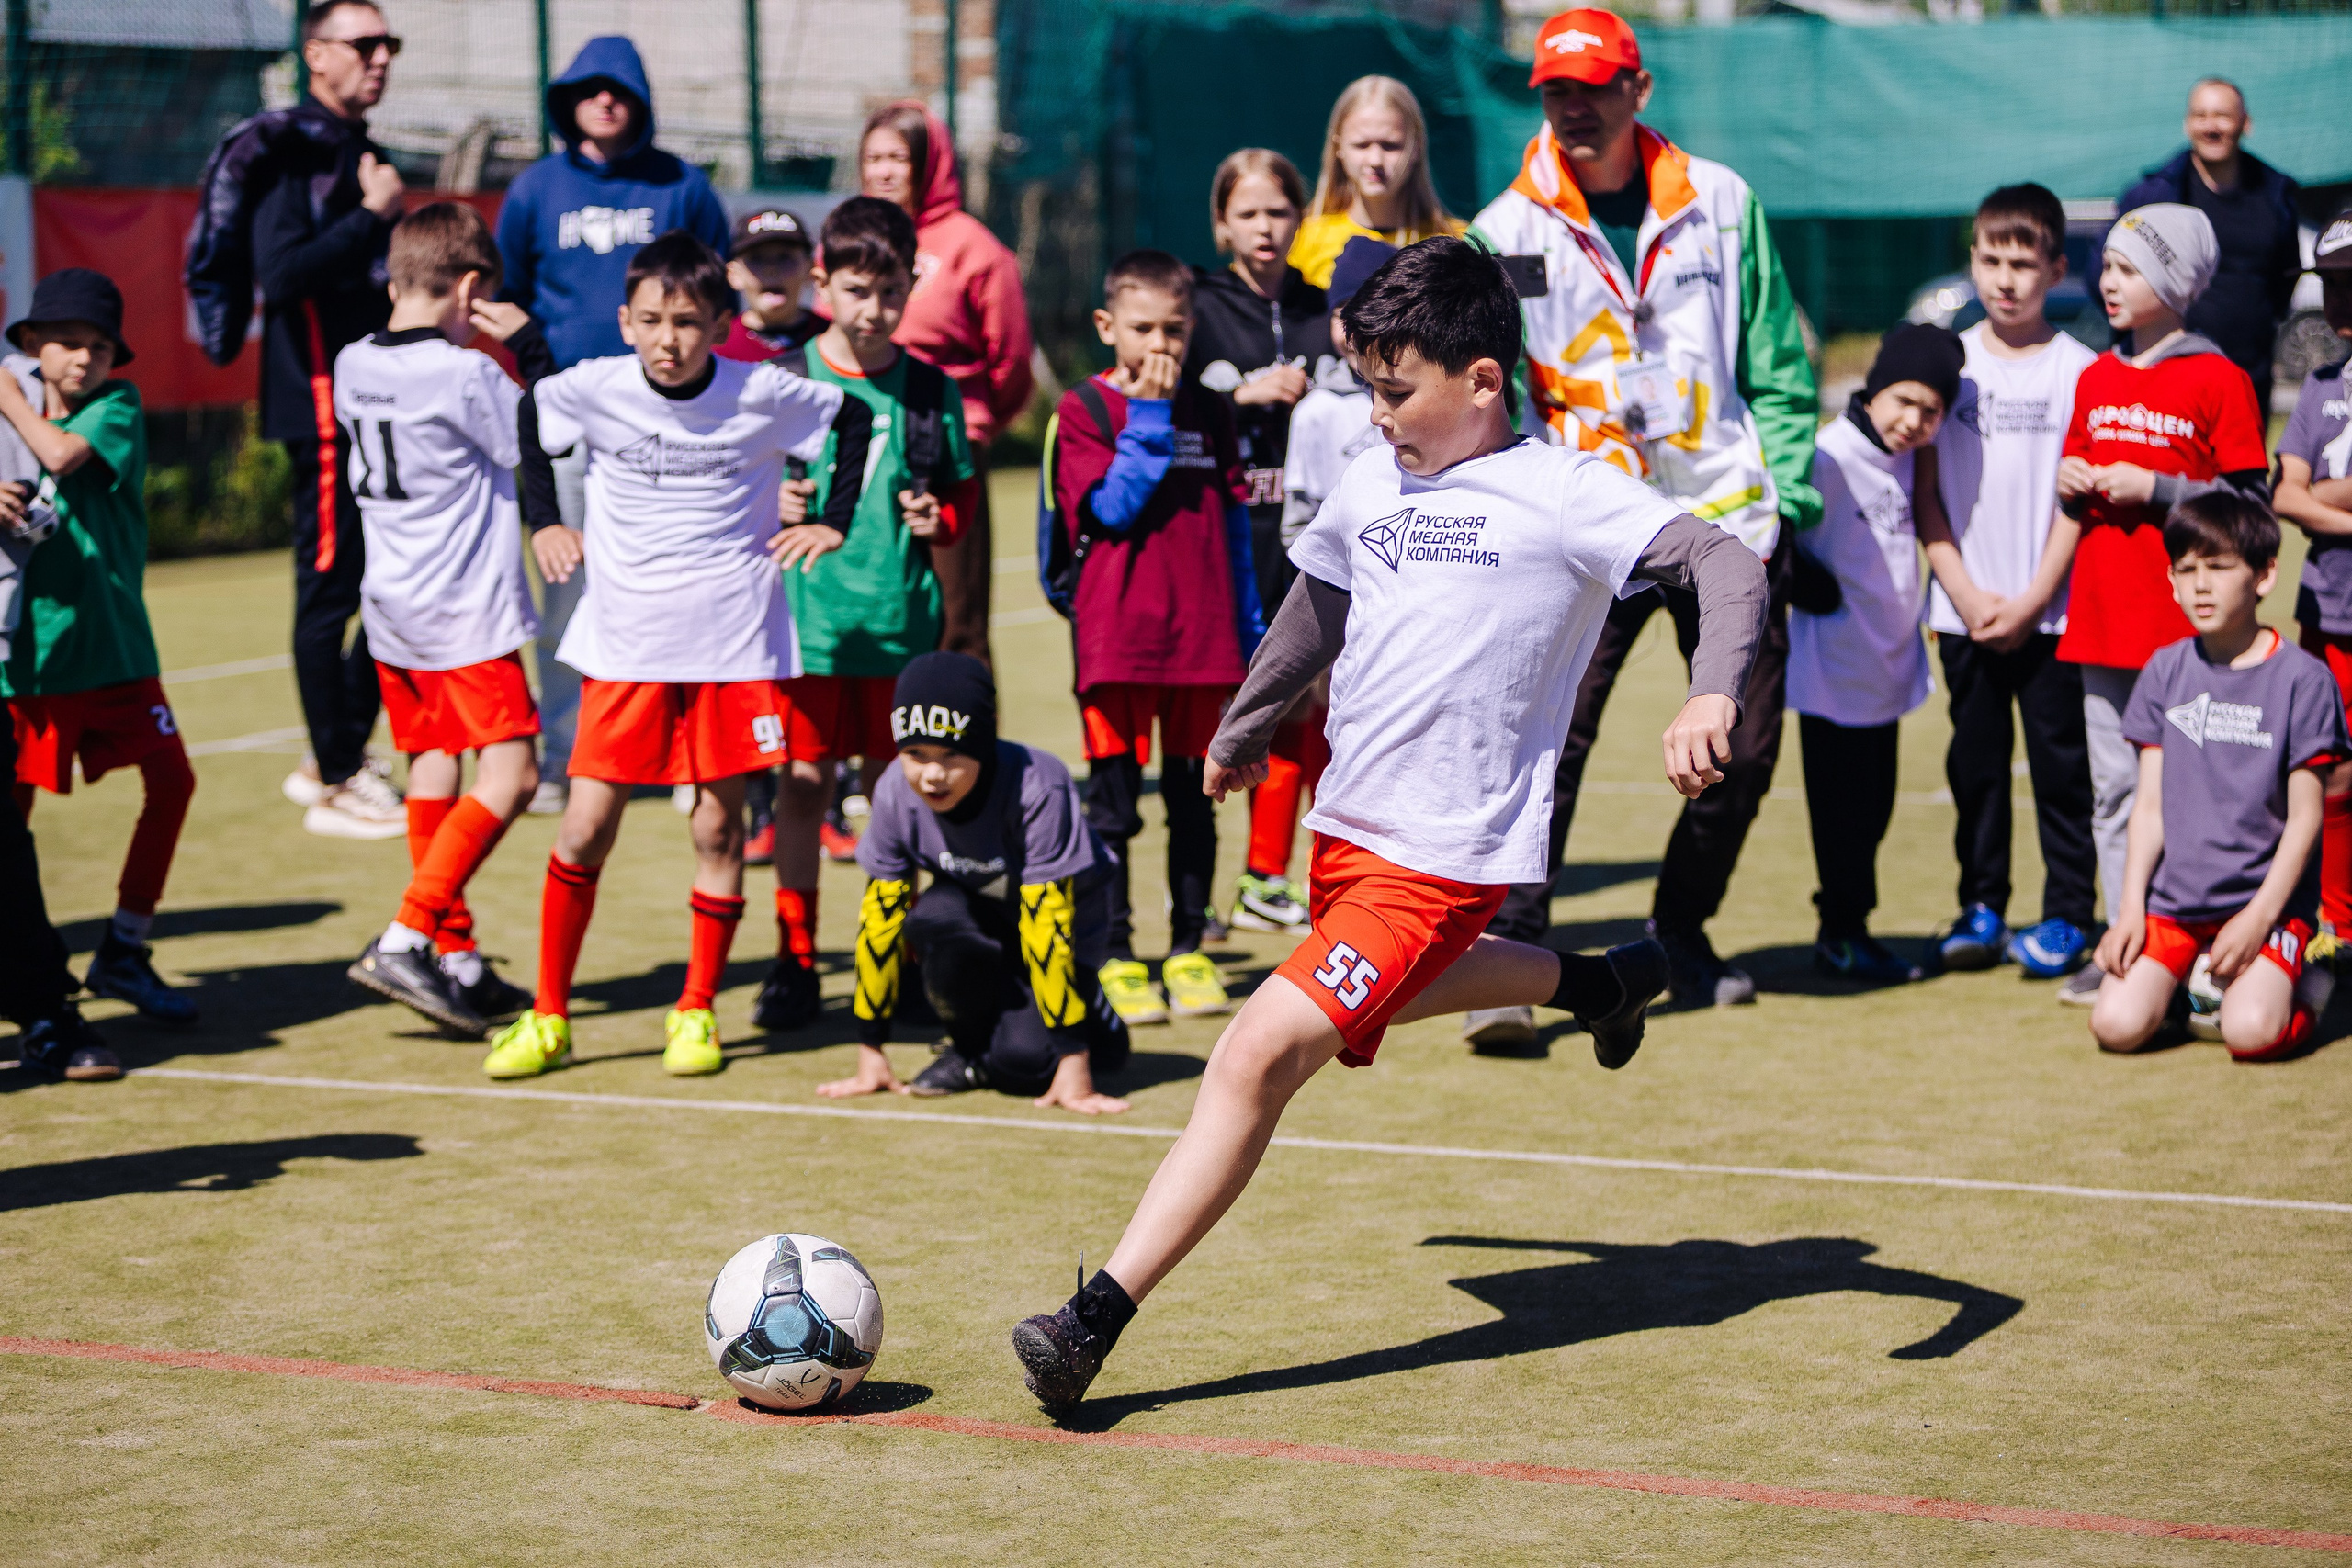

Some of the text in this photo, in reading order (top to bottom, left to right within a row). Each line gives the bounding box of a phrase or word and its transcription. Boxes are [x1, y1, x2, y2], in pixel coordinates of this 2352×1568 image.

[352, 418, 410, 500] 11
[1414, 514, 1487, 530] РУССКАЯ
[1408, 530, 1478, 547] МЕДНАЯ
[1406, 547, 1500, 568] КОМПАНИЯ
[1312, 940, 1381, 1011] 55
[775, 1377, 807, 1401] JÖGEL
[775, 1387, 791, 1400] TEAM
